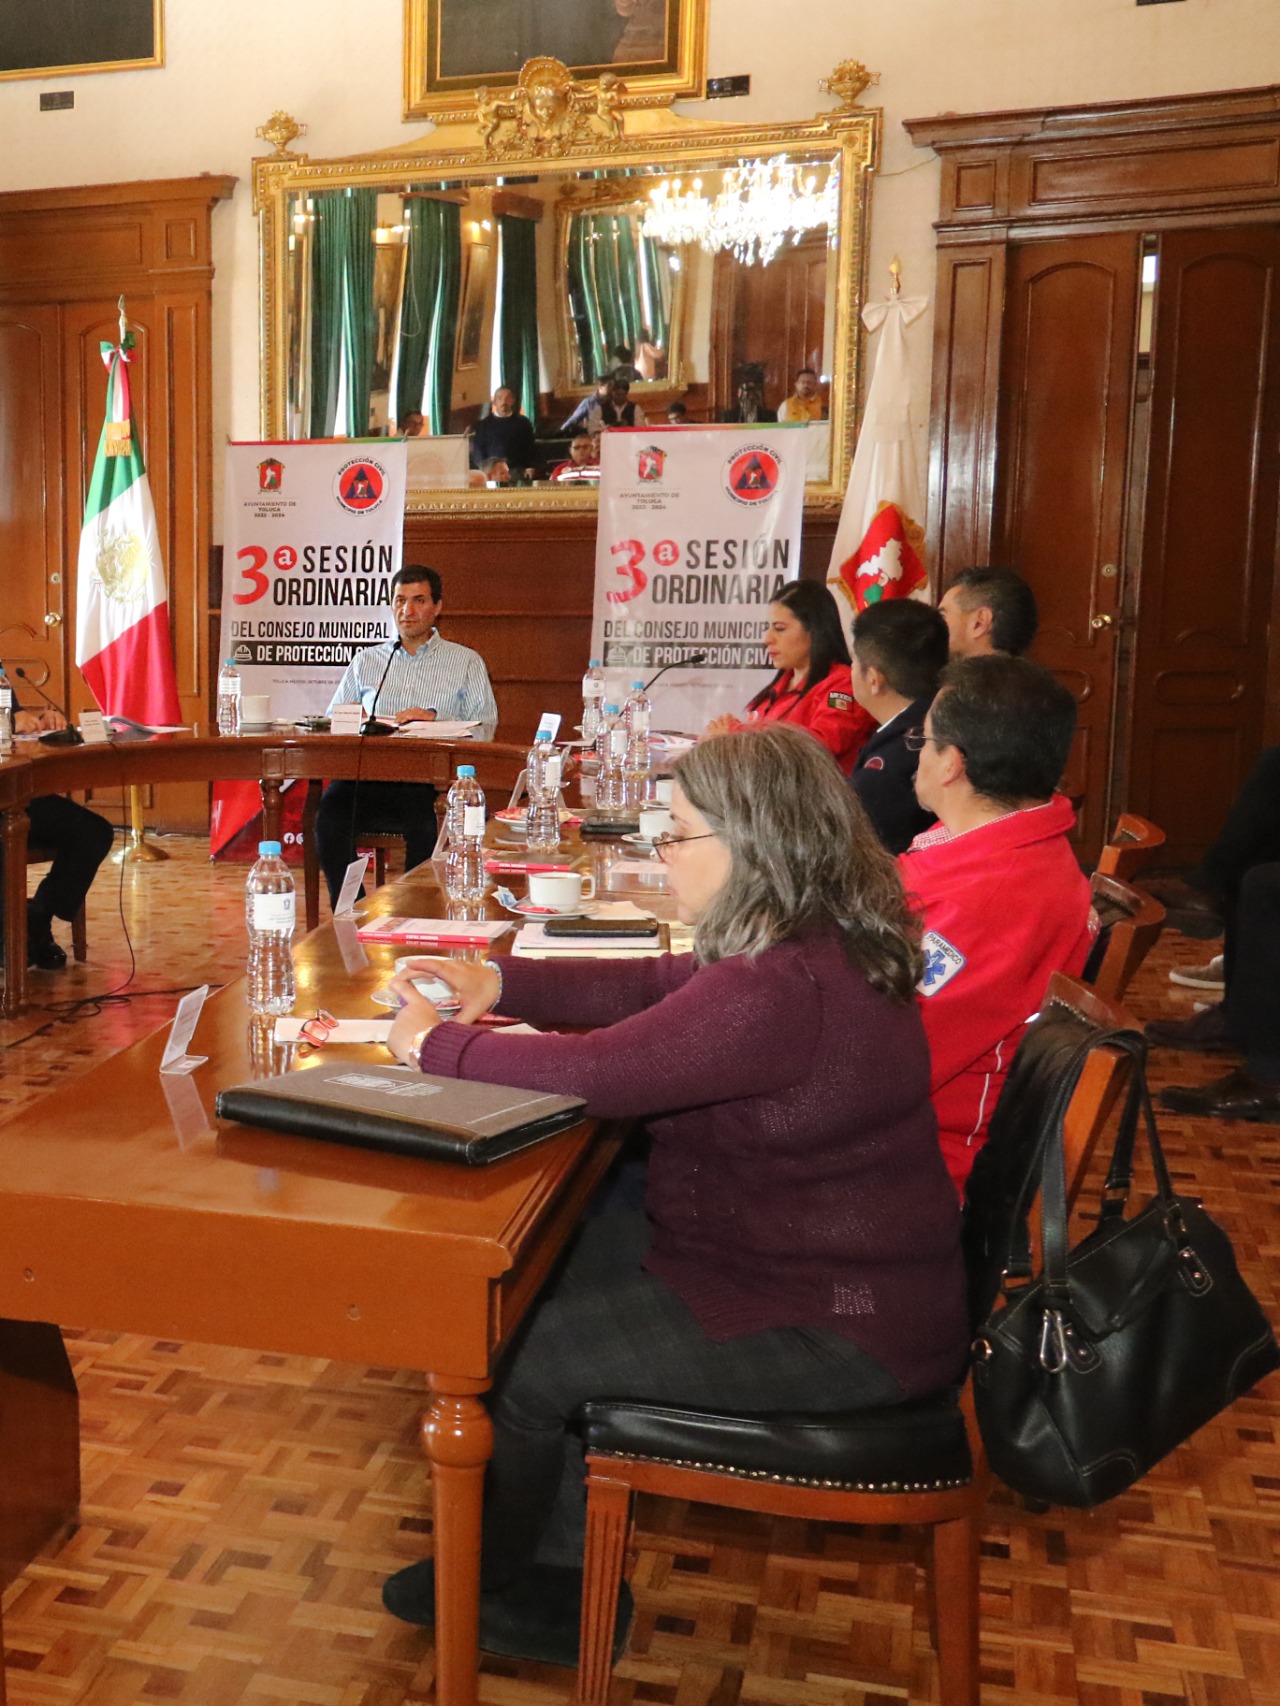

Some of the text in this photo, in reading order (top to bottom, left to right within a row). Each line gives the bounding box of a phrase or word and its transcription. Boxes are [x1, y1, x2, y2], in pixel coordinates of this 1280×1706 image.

[302, 540, 393, 573] SESIÓN
[686, 533, 790, 570] SESIÓN
[273, 578, 391, 606] ORDINARIA
[232, 621, 390, 638] DEL CONSEJO MUNICIPAL
[604, 620, 770, 639] DEL CONSEJO MUNICIP
[257, 645, 273, 662] DE
[276, 643, 353, 663] PROTECCIÓN
[633, 646, 651, 663] DE
